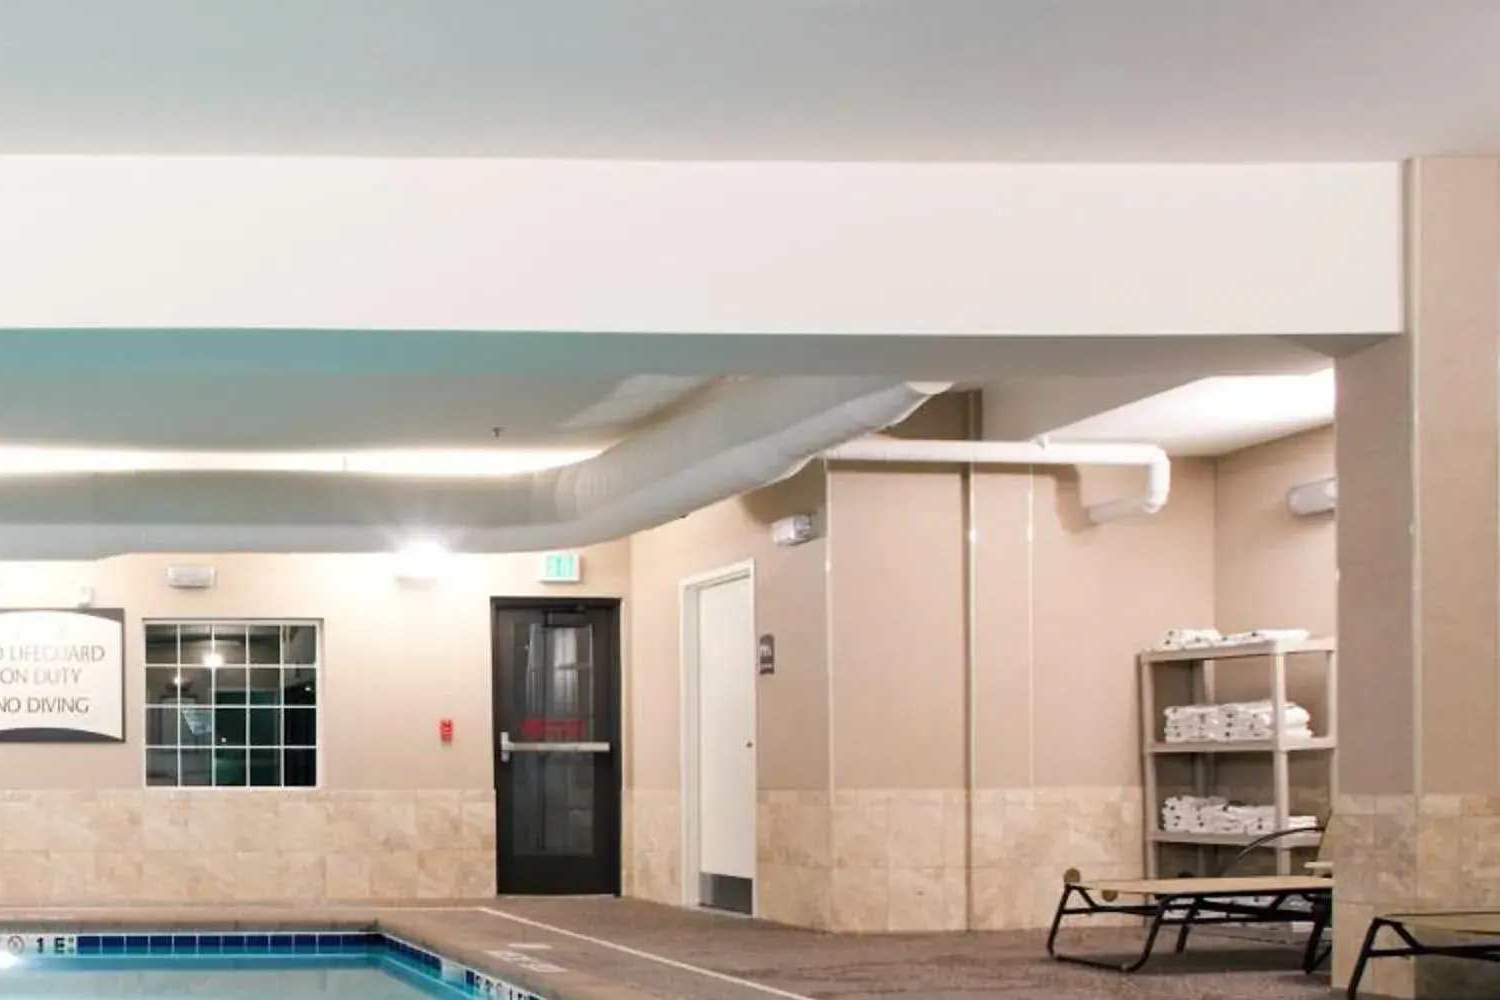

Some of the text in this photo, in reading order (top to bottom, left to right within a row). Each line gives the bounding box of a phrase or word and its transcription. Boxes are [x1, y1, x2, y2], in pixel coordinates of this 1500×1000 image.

[9, 644, 106, 662] LIFEGUARD
[0, 667, 82, 685] ON DUTY
[27, 697, 90, 713] DIVING
